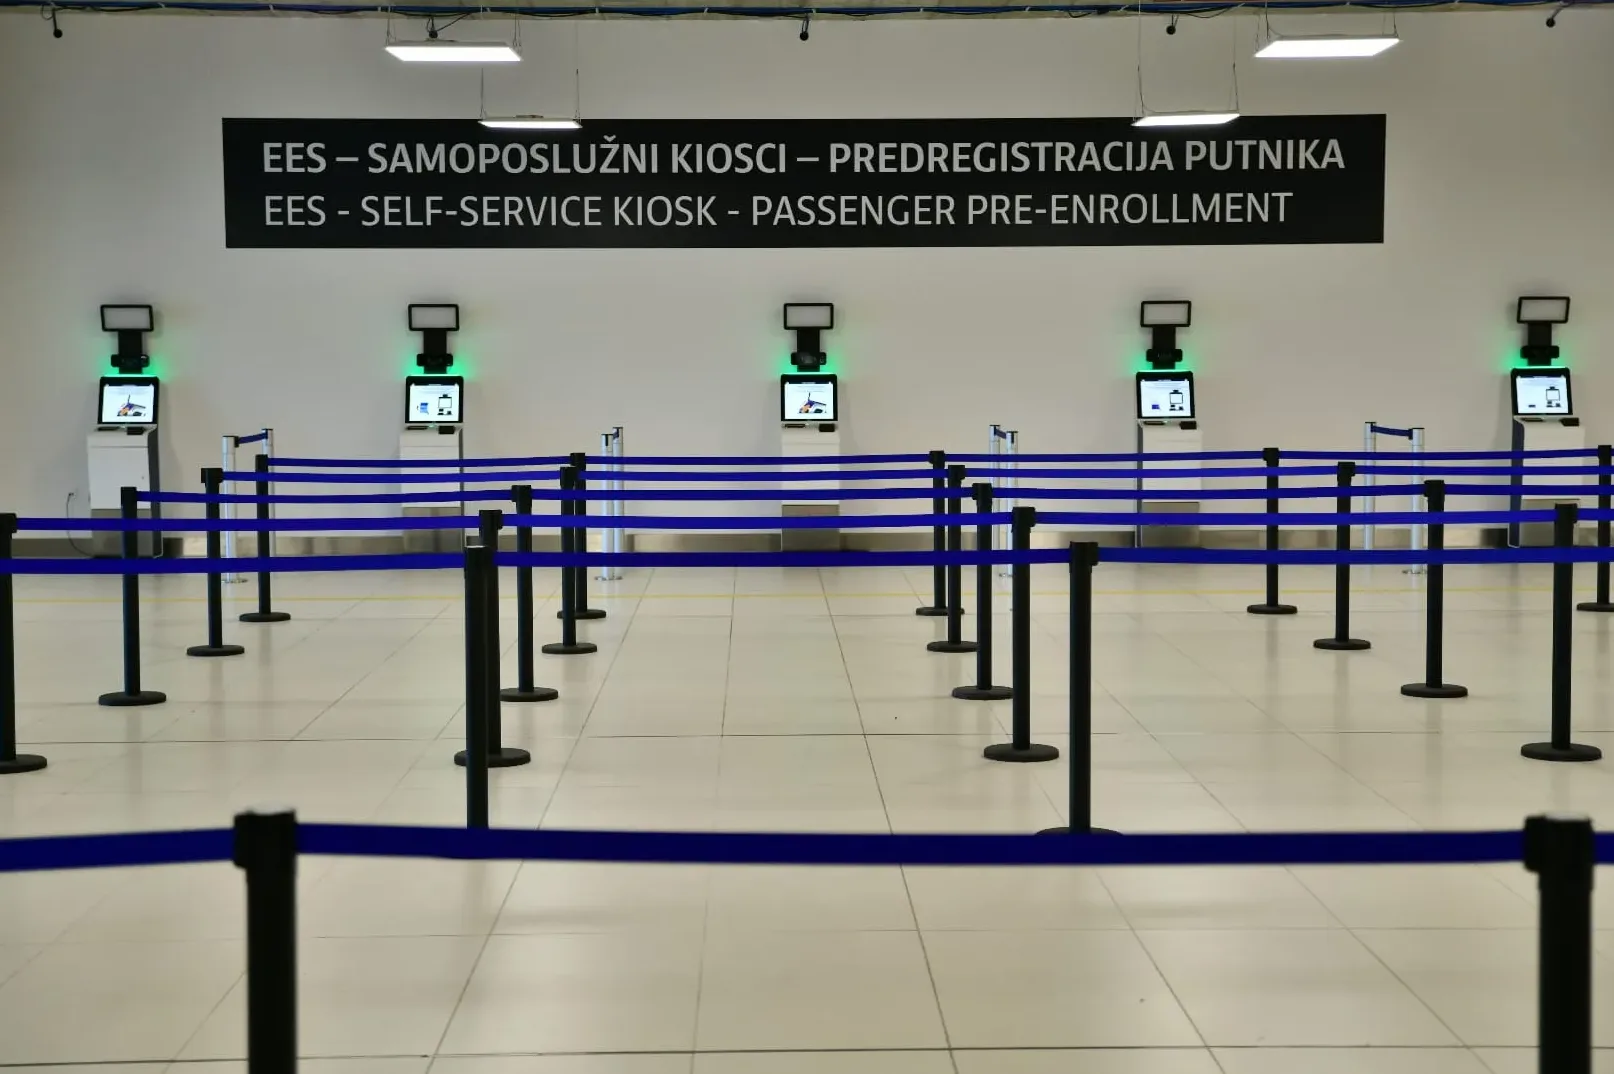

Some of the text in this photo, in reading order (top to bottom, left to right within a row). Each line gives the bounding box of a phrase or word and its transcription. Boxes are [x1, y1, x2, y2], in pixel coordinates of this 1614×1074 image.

[264, 142, 327, 174] EES
[368, 134, 658, 174] SAMOPOSLUŽNI
[671, 142, 786, 174] KIOSCI
[830, 140, 1174, 173] PREDREGISTRACIJA
[1185, 138, 1345, 171] PUTNIKA
[265, 195, 326, 227] EES
[361, 195, 602, 227] SELF-SERVICE
[614, 195, 718, 227] KIOSK
[752, 195, 956, 226] PASSENGER
[968, 192, 1294, 225] PRE-ENROLLMENT
